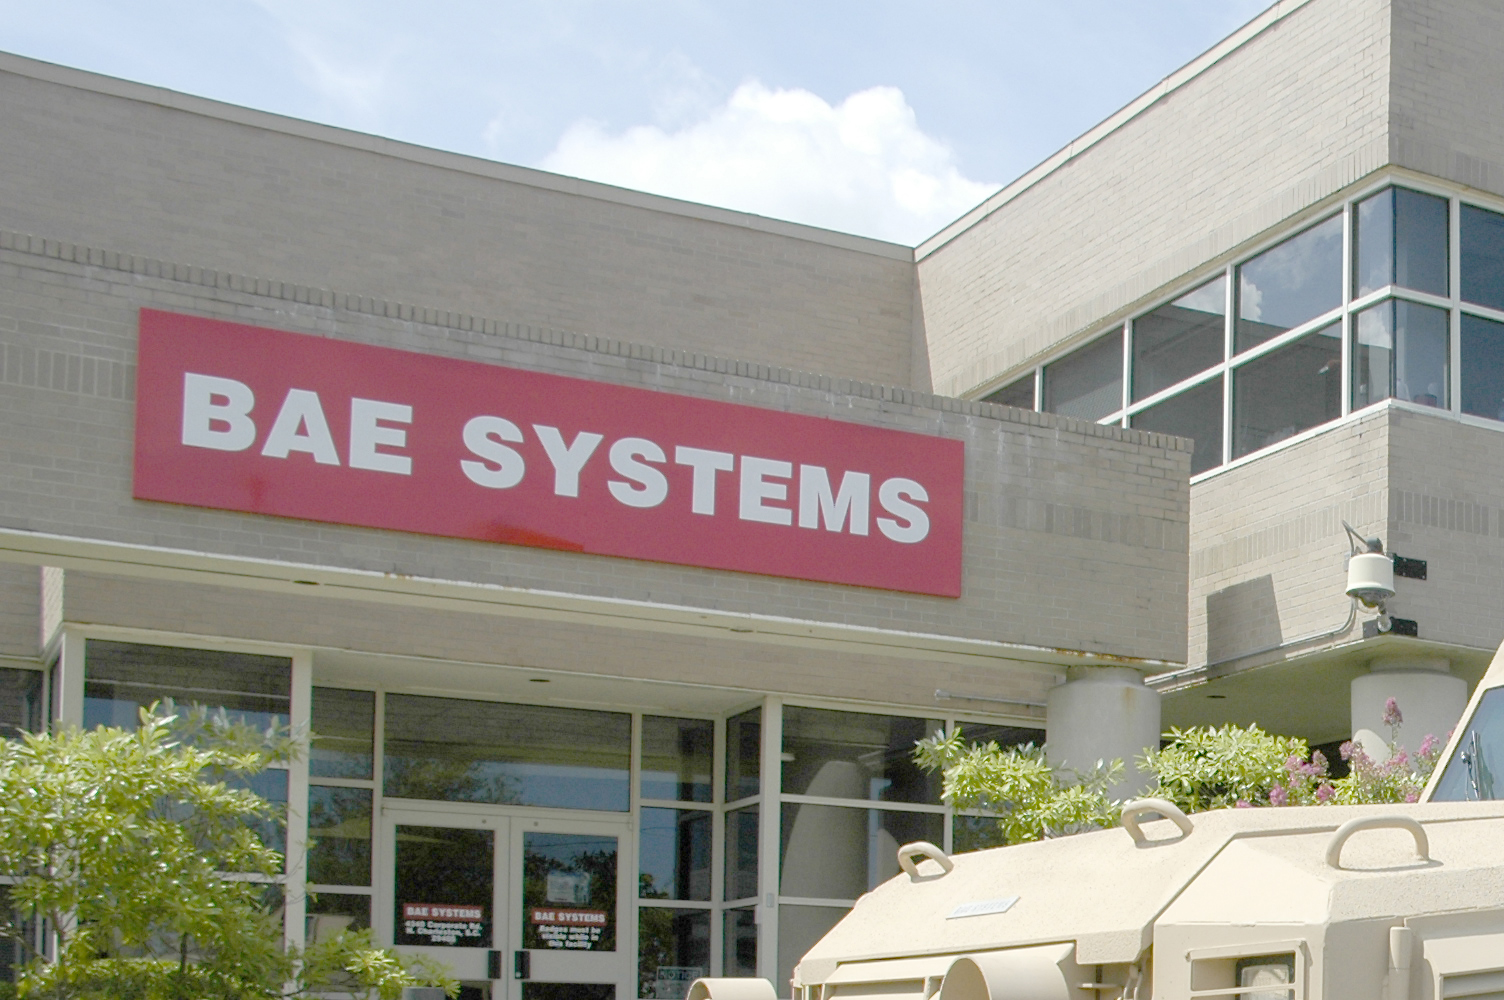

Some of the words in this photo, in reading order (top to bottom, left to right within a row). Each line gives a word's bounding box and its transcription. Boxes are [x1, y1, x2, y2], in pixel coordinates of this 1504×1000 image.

[181, 371, 413, 476] BAE
[460, 415, 931, 544] SYSTEMS
[407, 907, 428, 916] BAE
[431, 908, 481, 918] SYSTEMS
[535, 912, 555, 921] BAE
[558, 912, 605, 922] SYSTEMS
[427, 921, 467, 930] Corporate
[539, 925, 569, 935] Badges
[569, 926, 590, 934] must
[590, 926, 602, 934] be
[564, 940, 592, 950] facility
